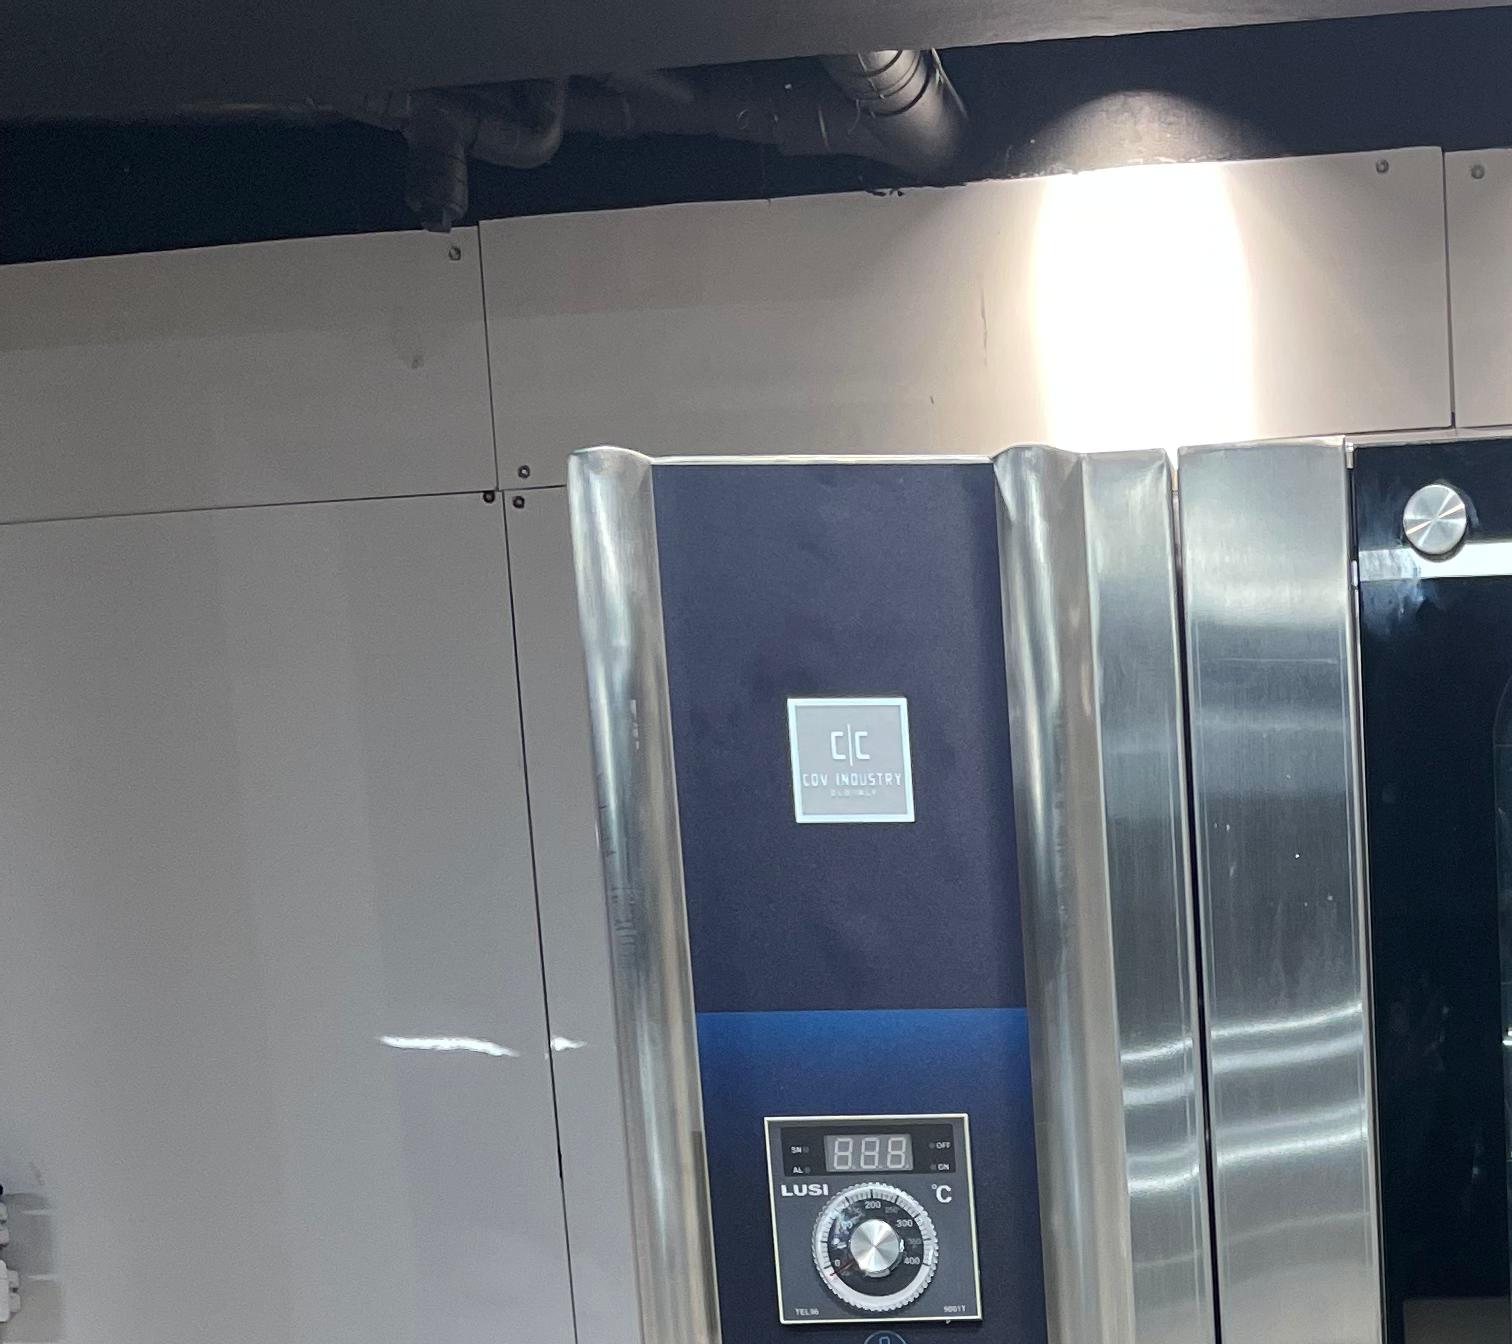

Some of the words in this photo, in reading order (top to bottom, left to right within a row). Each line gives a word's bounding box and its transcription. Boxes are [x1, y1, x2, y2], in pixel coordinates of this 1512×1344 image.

[836, 772, 902, 787] INDUSTRY
[781, 1184, 829, 1197] LUSI
[865, 1201, 881, 1209] 200
[895, 1220, 913, 1228] 300
[903, 1257, 921, 1265] 400
